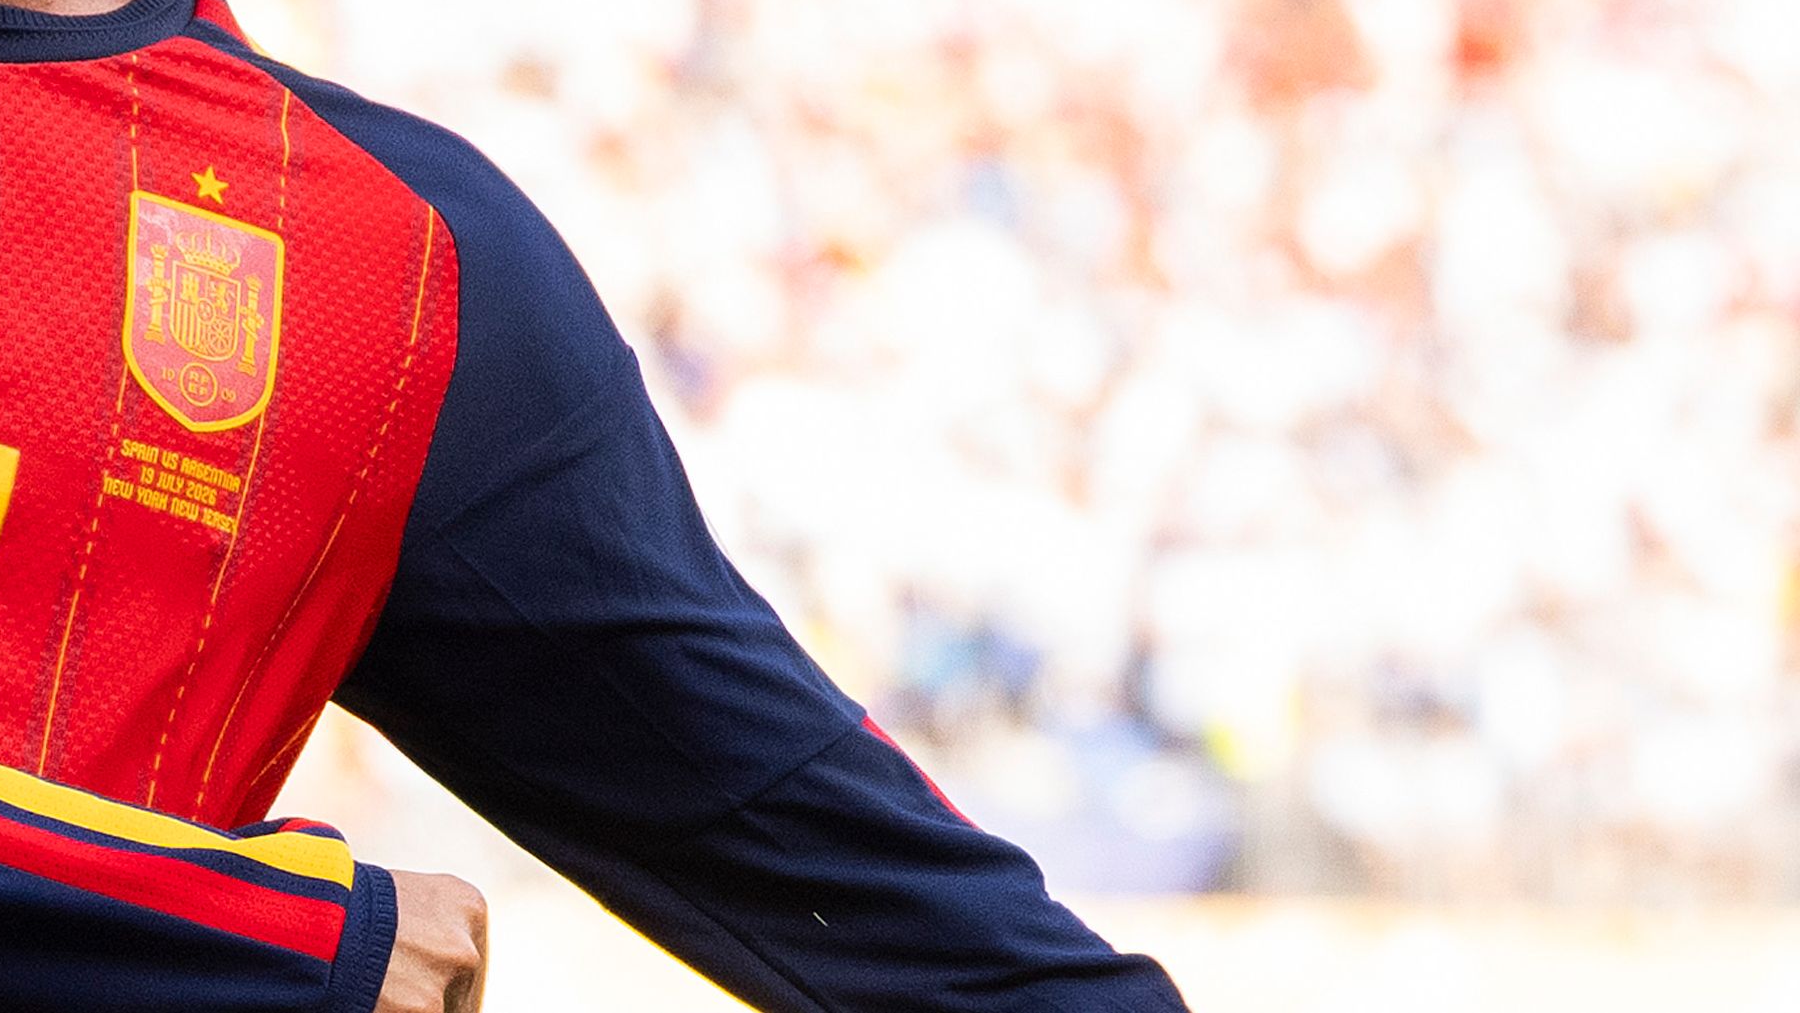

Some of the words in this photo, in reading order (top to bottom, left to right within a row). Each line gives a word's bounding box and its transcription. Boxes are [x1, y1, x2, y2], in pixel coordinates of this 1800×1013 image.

[120, 438, 159, 464] SPAIN
[180, 457, 242, 493] ARGENTINA
[140, 465, 155, 485] 19
[156, 470, 185, 494] JULY
[185, 479, 218, 506] 2026
[103, 476, 134, 500] NEW
[136, 486, 168, 511] YORK
[170, 496, 200, 522] NEW
